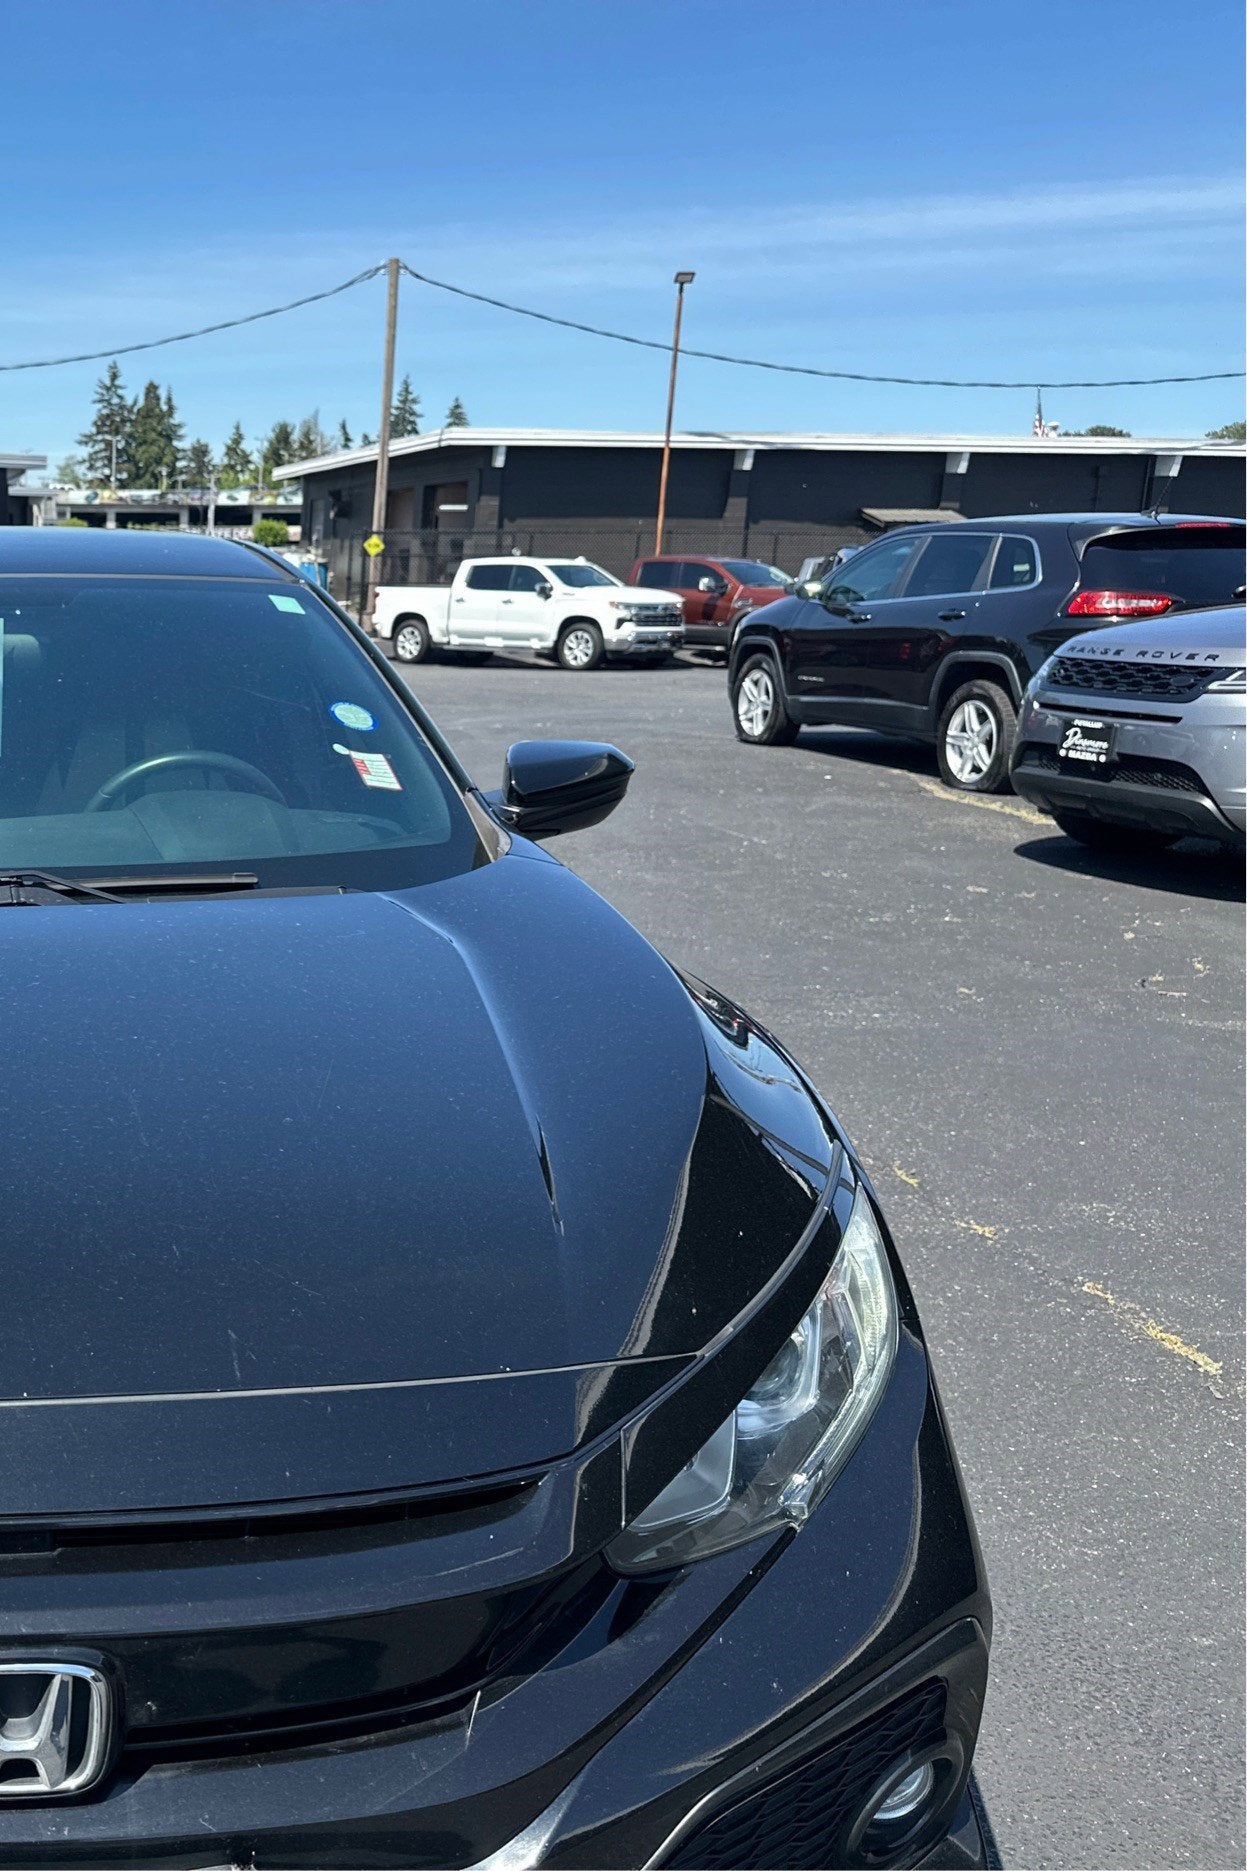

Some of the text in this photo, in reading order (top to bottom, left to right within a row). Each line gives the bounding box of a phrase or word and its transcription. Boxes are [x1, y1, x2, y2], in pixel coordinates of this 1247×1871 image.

[1067, 646, 1220, 662] RANGE ROVER
[1068, 749, 1097, 762] MAZDA
